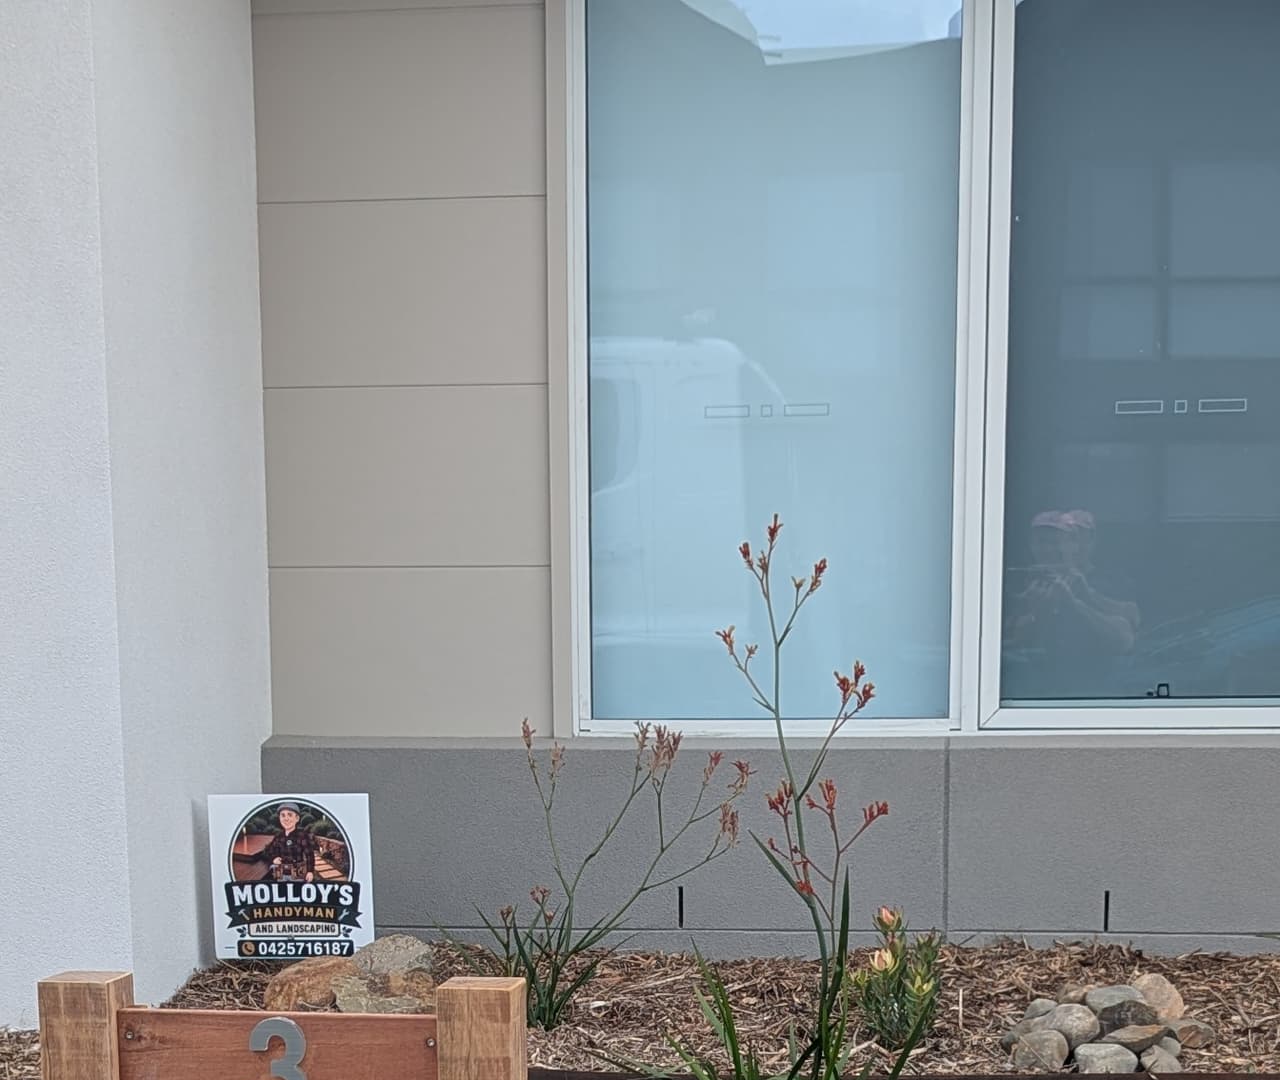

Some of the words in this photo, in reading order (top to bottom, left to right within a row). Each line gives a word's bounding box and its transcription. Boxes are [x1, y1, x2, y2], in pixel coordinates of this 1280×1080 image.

[231, 883, 353, 906] MOLLOY'S
[253, 906, 335, 919] HANDYMAN
[255, 923, 274, 933] AND
[276, 923, 336, 934] LANDSCAPING
[258, 942, 350, 955] 0425716187
